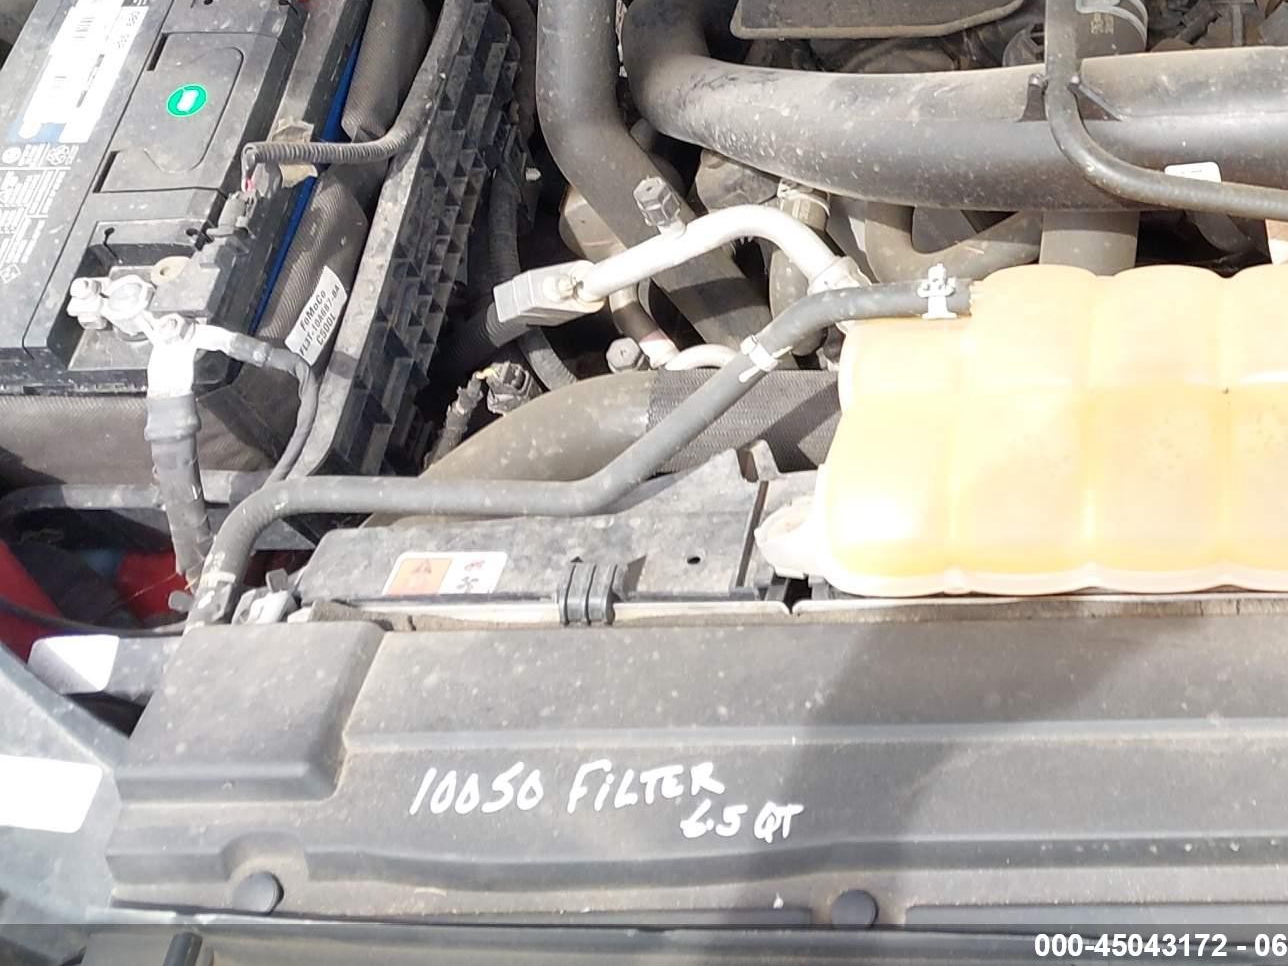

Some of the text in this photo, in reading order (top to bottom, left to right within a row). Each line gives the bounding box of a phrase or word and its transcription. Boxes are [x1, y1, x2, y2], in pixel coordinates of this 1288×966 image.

[300, 289, 327, 331] FoMoCo
[409, 760, 545, 816] 10050
[753, 800, 804, 844] QT
